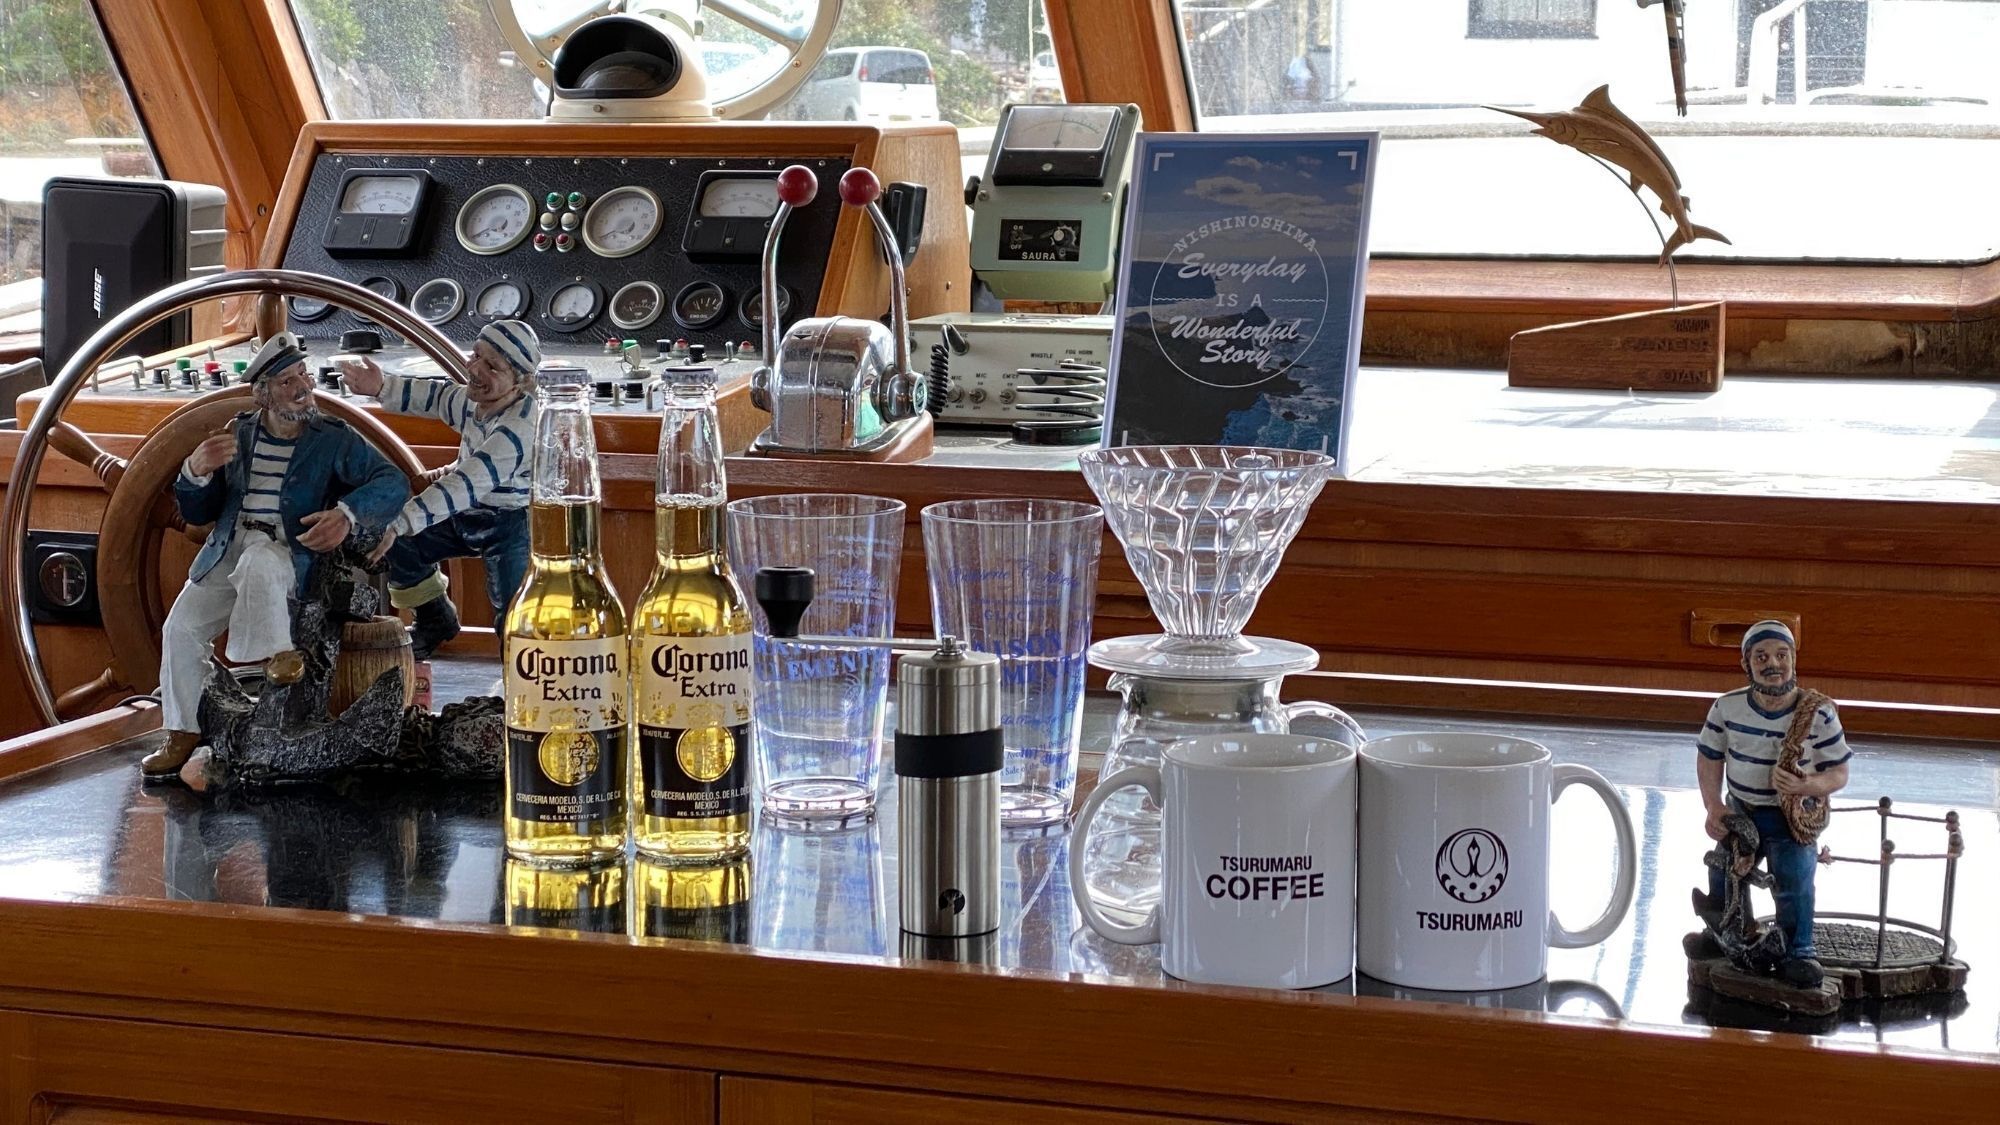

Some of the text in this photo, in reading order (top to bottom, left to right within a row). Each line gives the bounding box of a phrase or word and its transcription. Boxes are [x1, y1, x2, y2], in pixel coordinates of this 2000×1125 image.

[1174, 215, 1318, 252] NISHINOSHIMA
[1021, 251, 1056, 260] SAURA
[1177, 253, 1307, 283] Everyday
[94, 267, 102, 319] BOSE
[1216, 293, 1263, 308] IS A
[1169, 316, 1301, 347] Wonderful
[1199, 340, 1272, 369] Story
[516, 647, 618, 685] Corona
[651, 643, 749, 682] Corona
[542, 679, 602, 701] Extra
[680, 676, 736, 698] Extra
[516, 792, 548, 804] CERVECERIA
[651, 789, 686, 800] CERVECERIA
[694, 800, 720, 810] MEXICO
[557, 805, 582, 814] MEXICO
[1219, 855, 1313, 873] TSURUMARU
[1205, 872, 1325, 901] COFFEE
[1416, 909, 1523, 931] TSURUMARU
